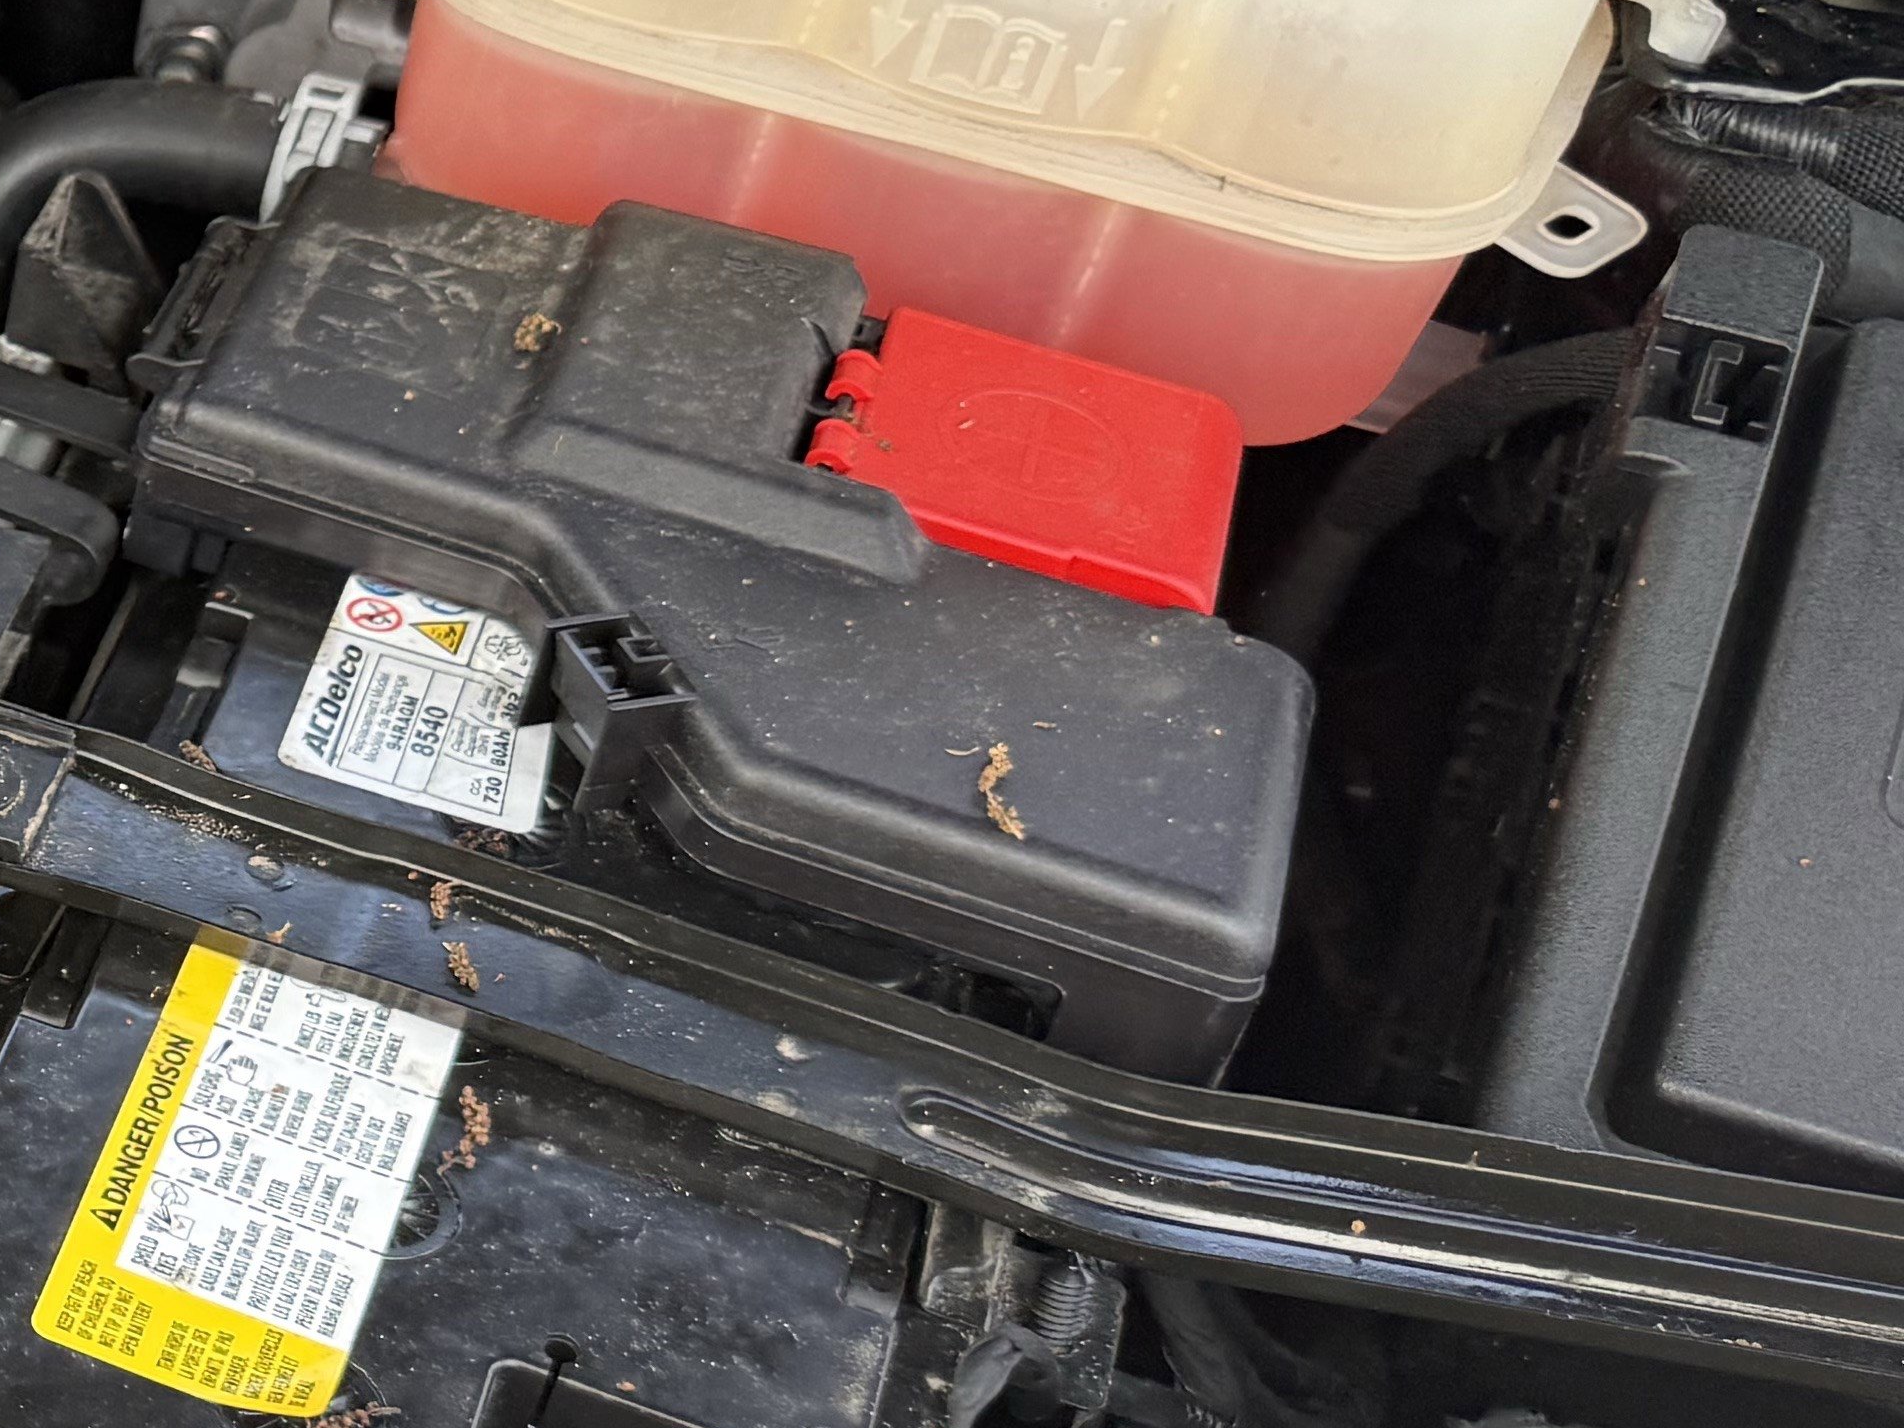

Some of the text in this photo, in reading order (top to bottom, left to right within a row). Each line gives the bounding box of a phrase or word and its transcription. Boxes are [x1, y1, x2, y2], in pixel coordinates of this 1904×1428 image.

[304, 644, 363, 757] ACDelco
[420, 706, 448, 758] 8540
[490, 726, 511, 767] 80Ah
[483, 776, 503, 804] 730
[102, 1033, 193, 1205] DANGER/POISON
